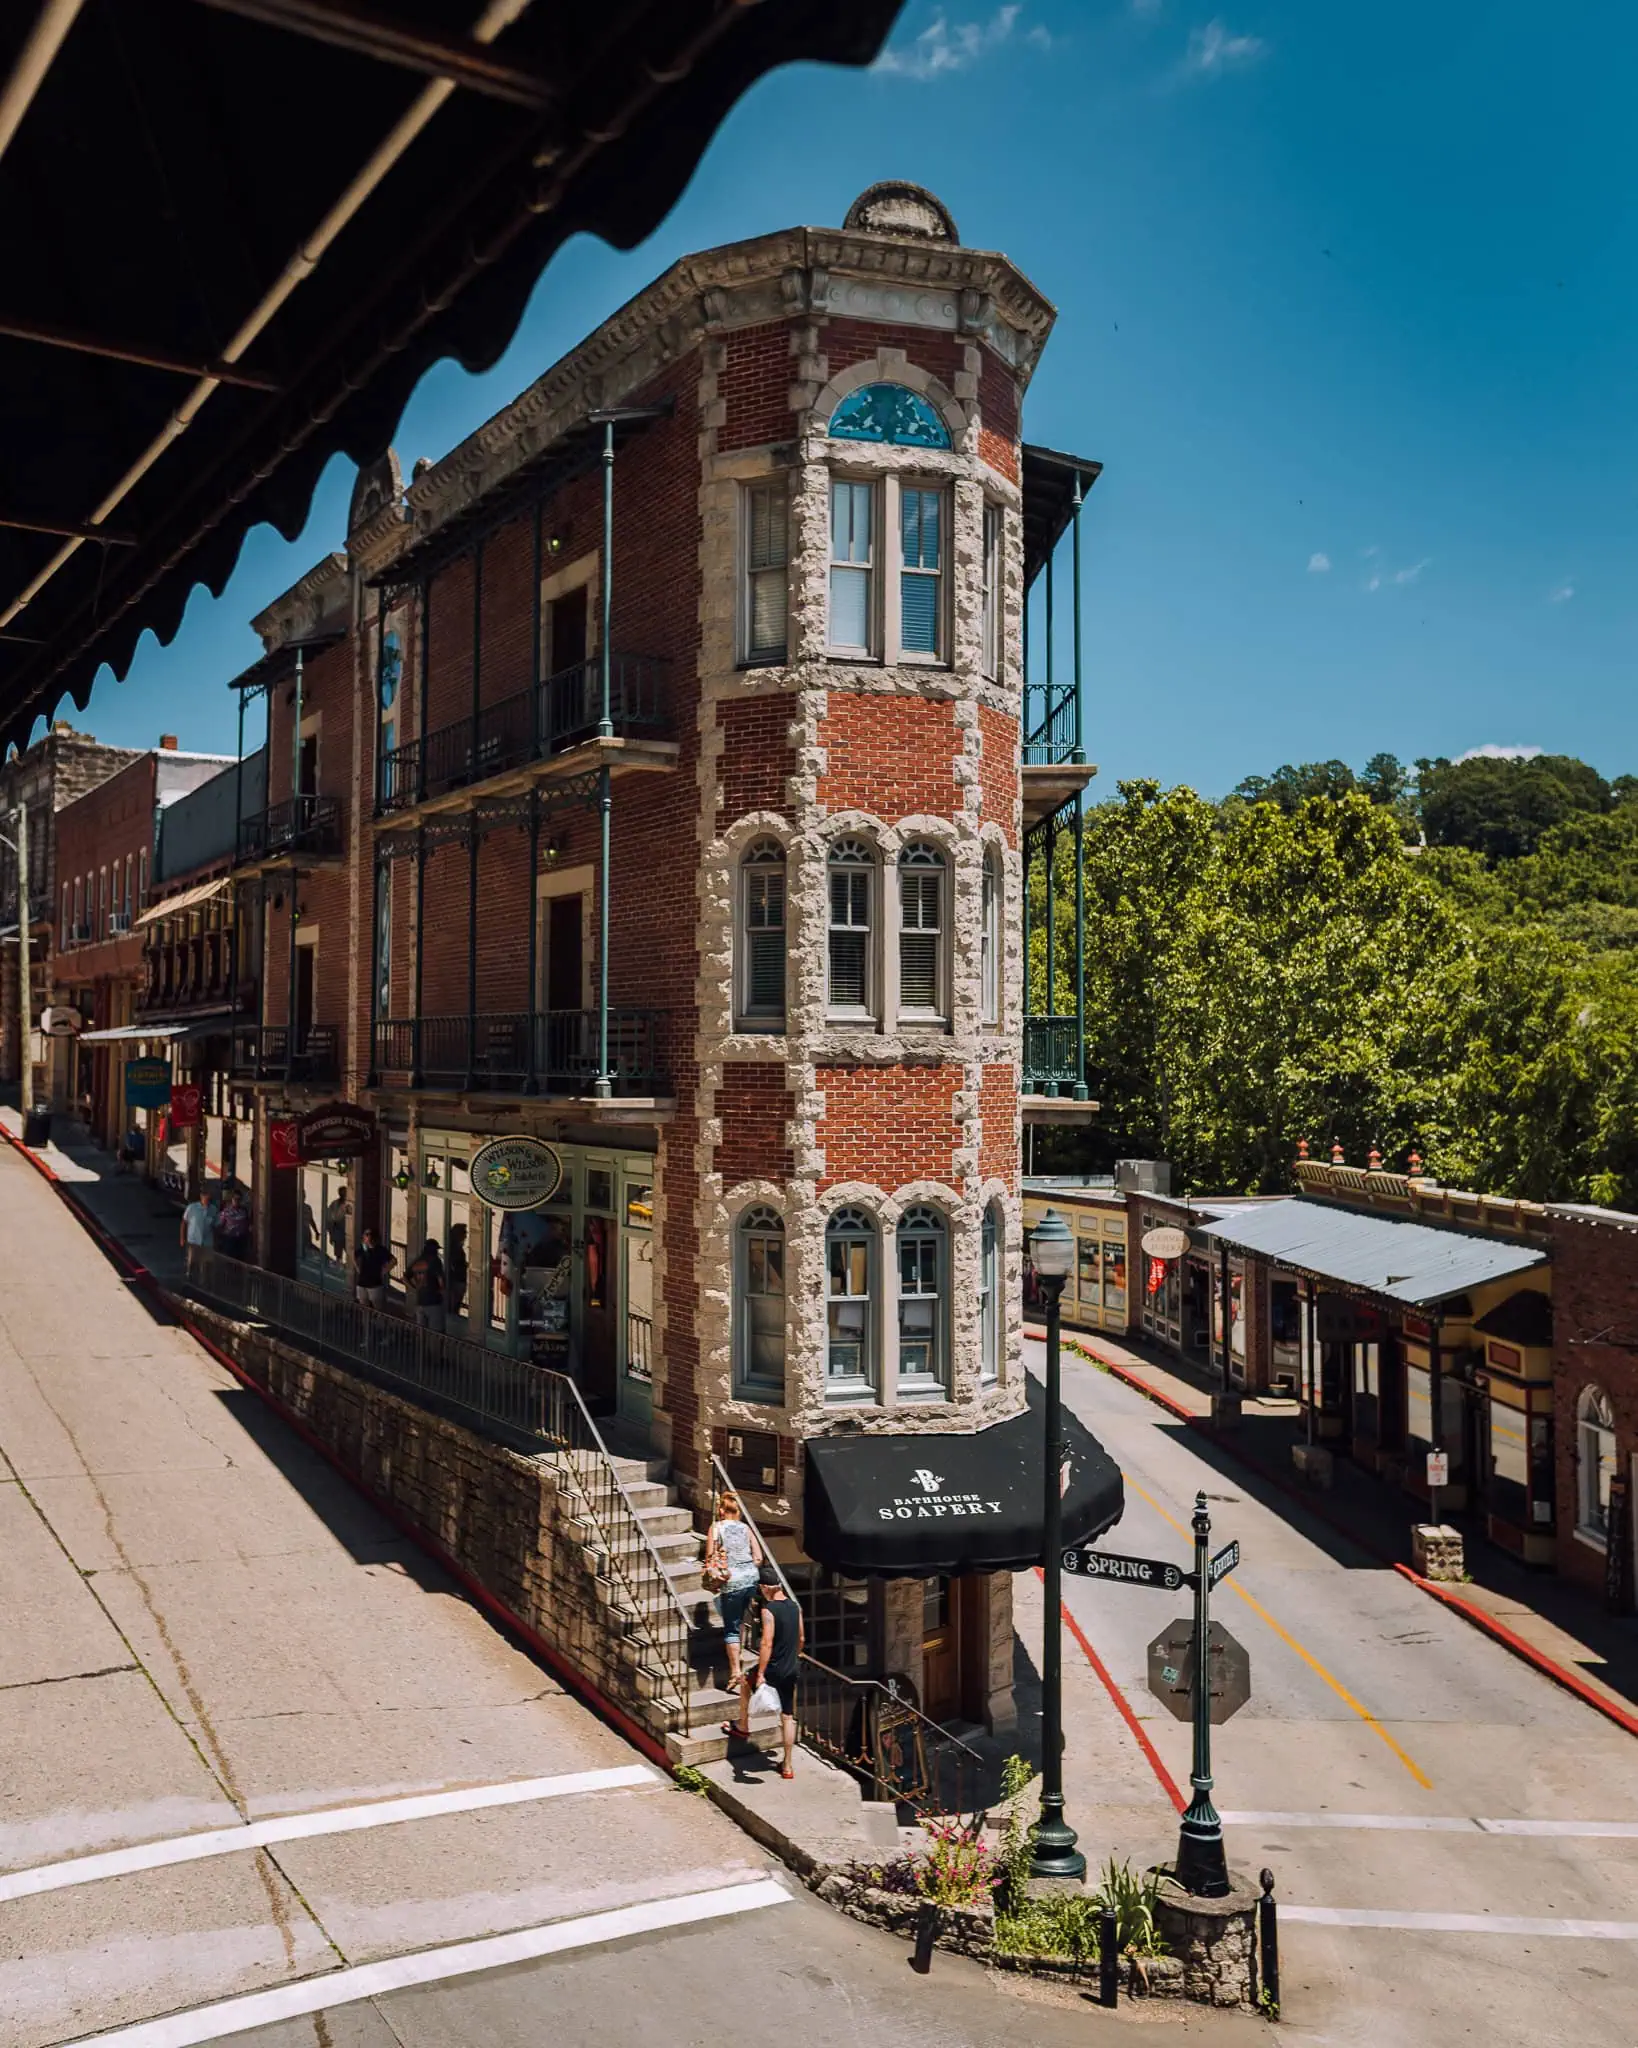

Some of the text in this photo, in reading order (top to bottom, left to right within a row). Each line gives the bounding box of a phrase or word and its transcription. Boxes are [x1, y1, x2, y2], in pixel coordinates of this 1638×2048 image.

[506, 1157, 547, 1170] WILSON
[893, 1494, 980, 1506] BATHHOUSE
[878, 1501, 1003, 1520] SOAPERY
